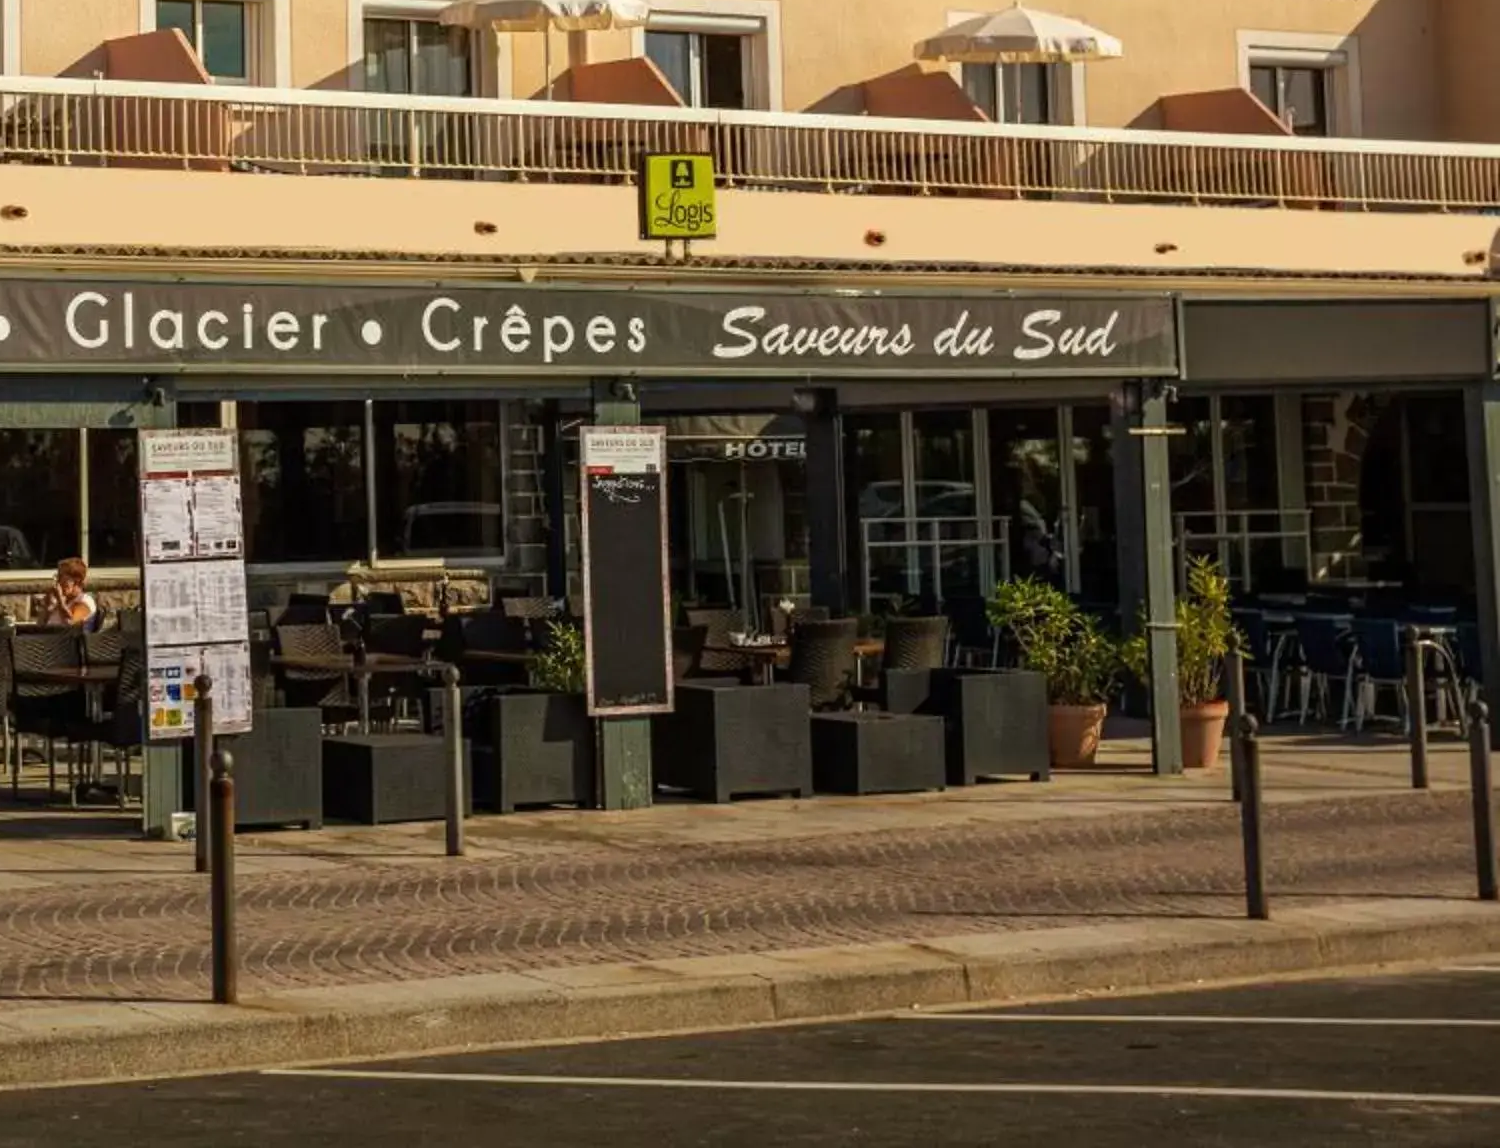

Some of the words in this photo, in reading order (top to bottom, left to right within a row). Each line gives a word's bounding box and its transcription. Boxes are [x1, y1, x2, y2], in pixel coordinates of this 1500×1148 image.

[654, 189, 713, 231] Logis
[65, 291, 328, 350] Glacier
[421, 297, 647, 362] Crêpes
[713, 305, 915, 358] Saveurs
[933, 310, 995, 356] du
[1013, 309, 1120, 360] Sud
